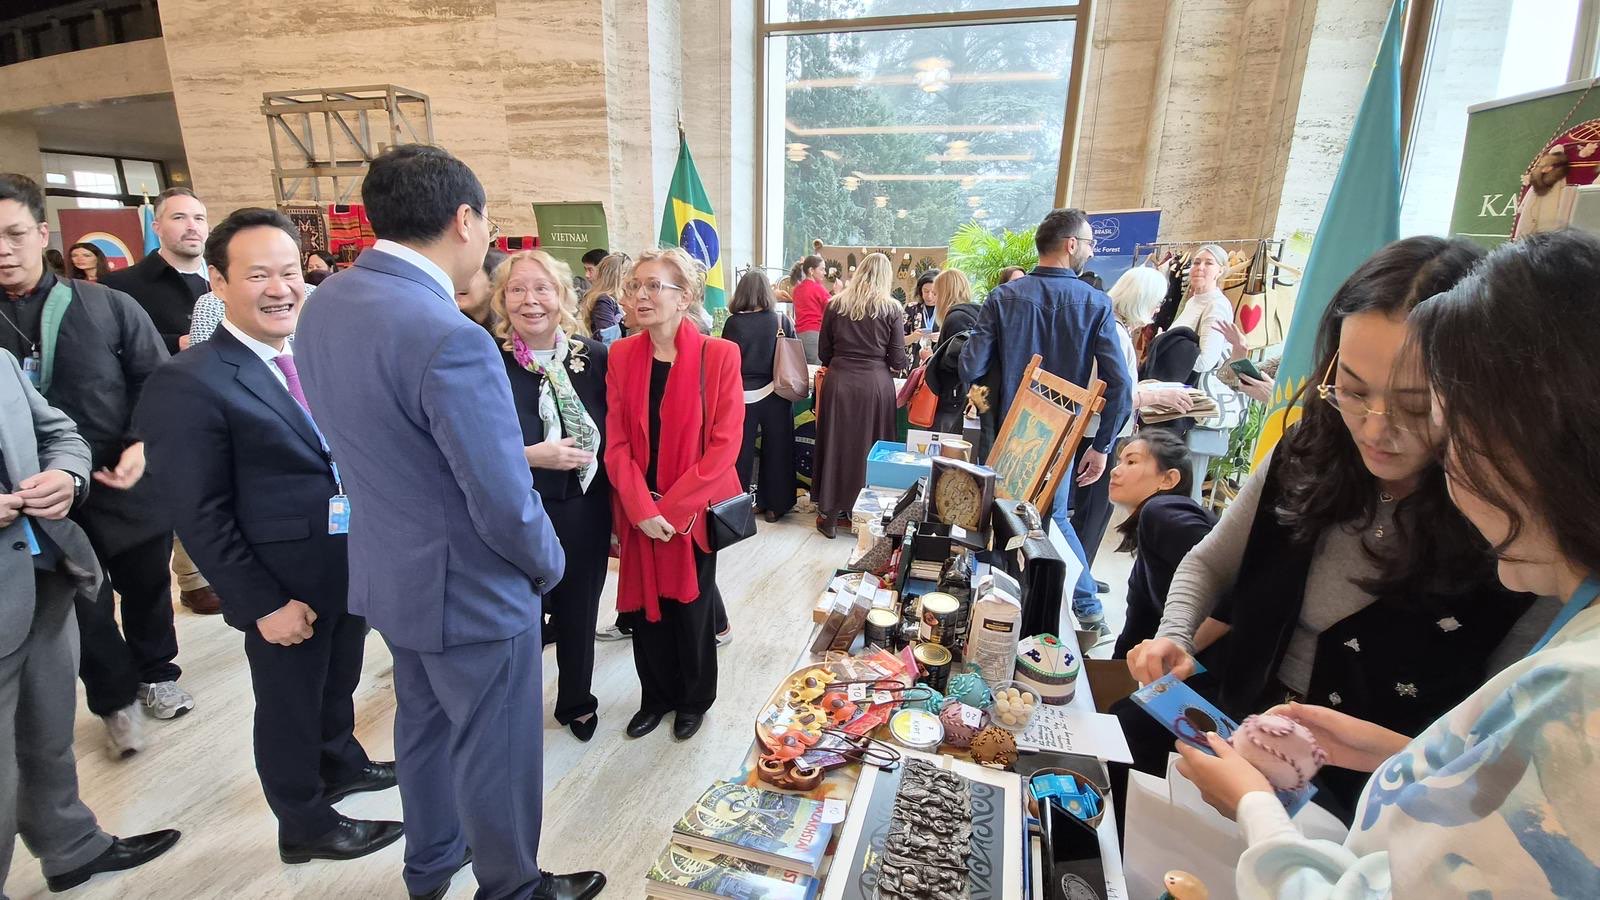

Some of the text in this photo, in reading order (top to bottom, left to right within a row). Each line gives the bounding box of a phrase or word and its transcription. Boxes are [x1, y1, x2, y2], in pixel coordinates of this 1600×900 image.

[1477, 192, 1519, 217] KA
[551, 232, 588, 243] VIETNAM
[853, 686, 862, 698] 10
[965, 711, 977, 721] 20
